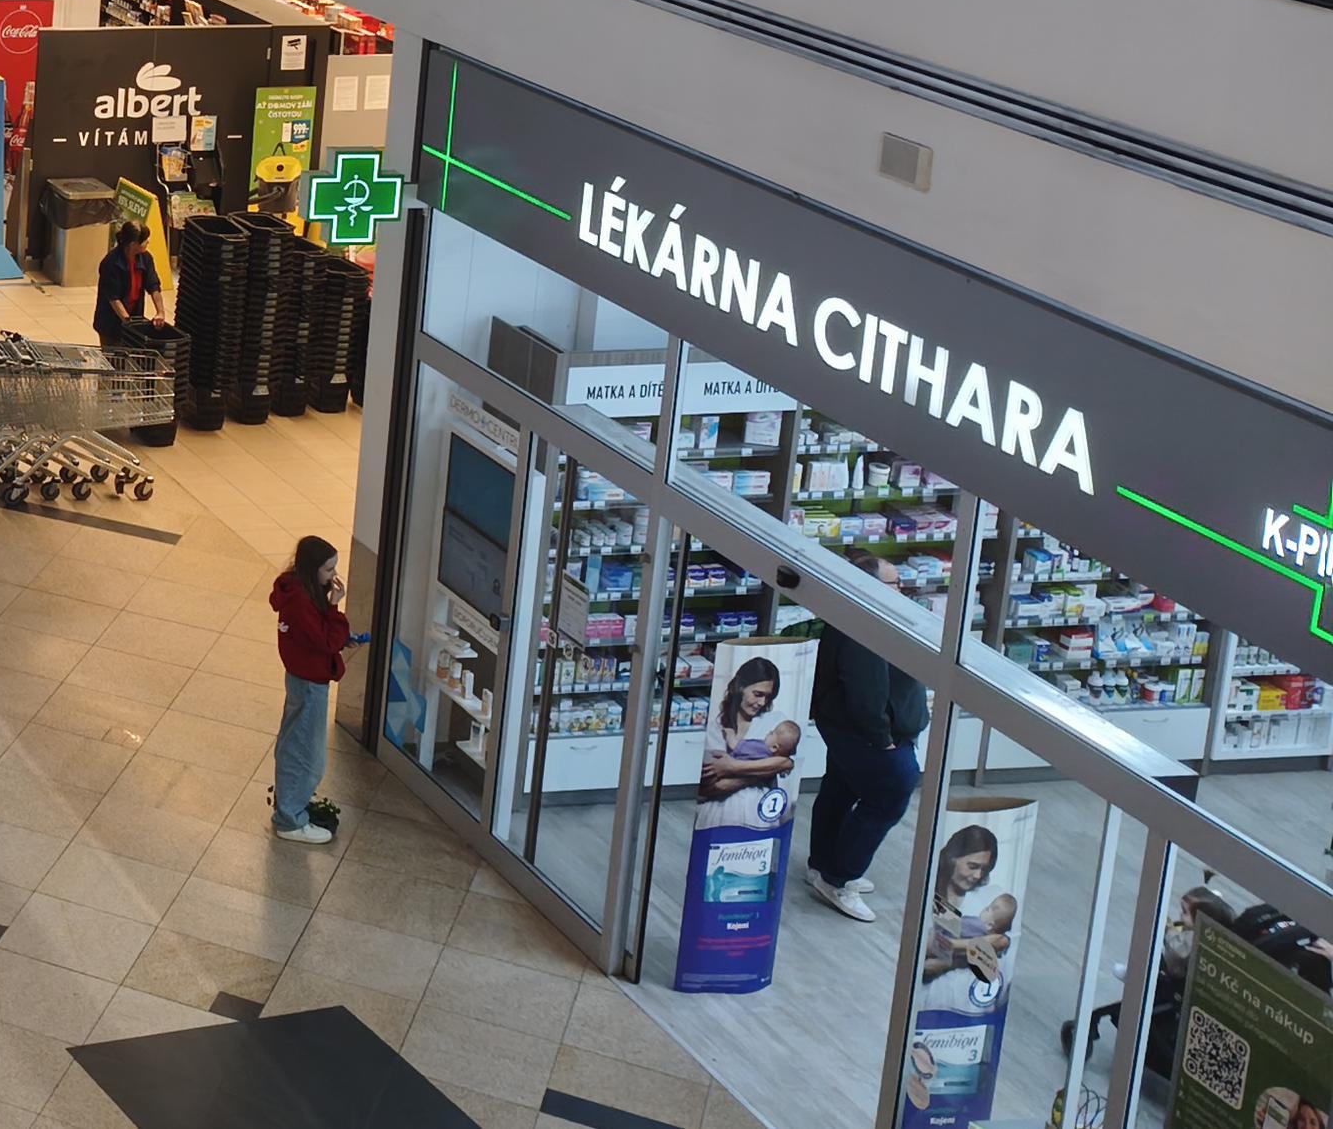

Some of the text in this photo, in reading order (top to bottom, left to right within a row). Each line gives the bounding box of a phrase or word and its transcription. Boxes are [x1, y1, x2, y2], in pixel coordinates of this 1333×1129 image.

[94, 86, 202, 119] albert
[78, 127, 148, 147] VÍTÁM
[577, 176, 1095, 497] LÉKÁRNA CITHARA
[586, 384, 625, 400] MATKA
[628, 384, 636, 399] A
[703, 380, 741, 396] MATKA
[744, 380, 752, 394] A
[1198, 956, 1315, 1046] 50 Kč na nákup
